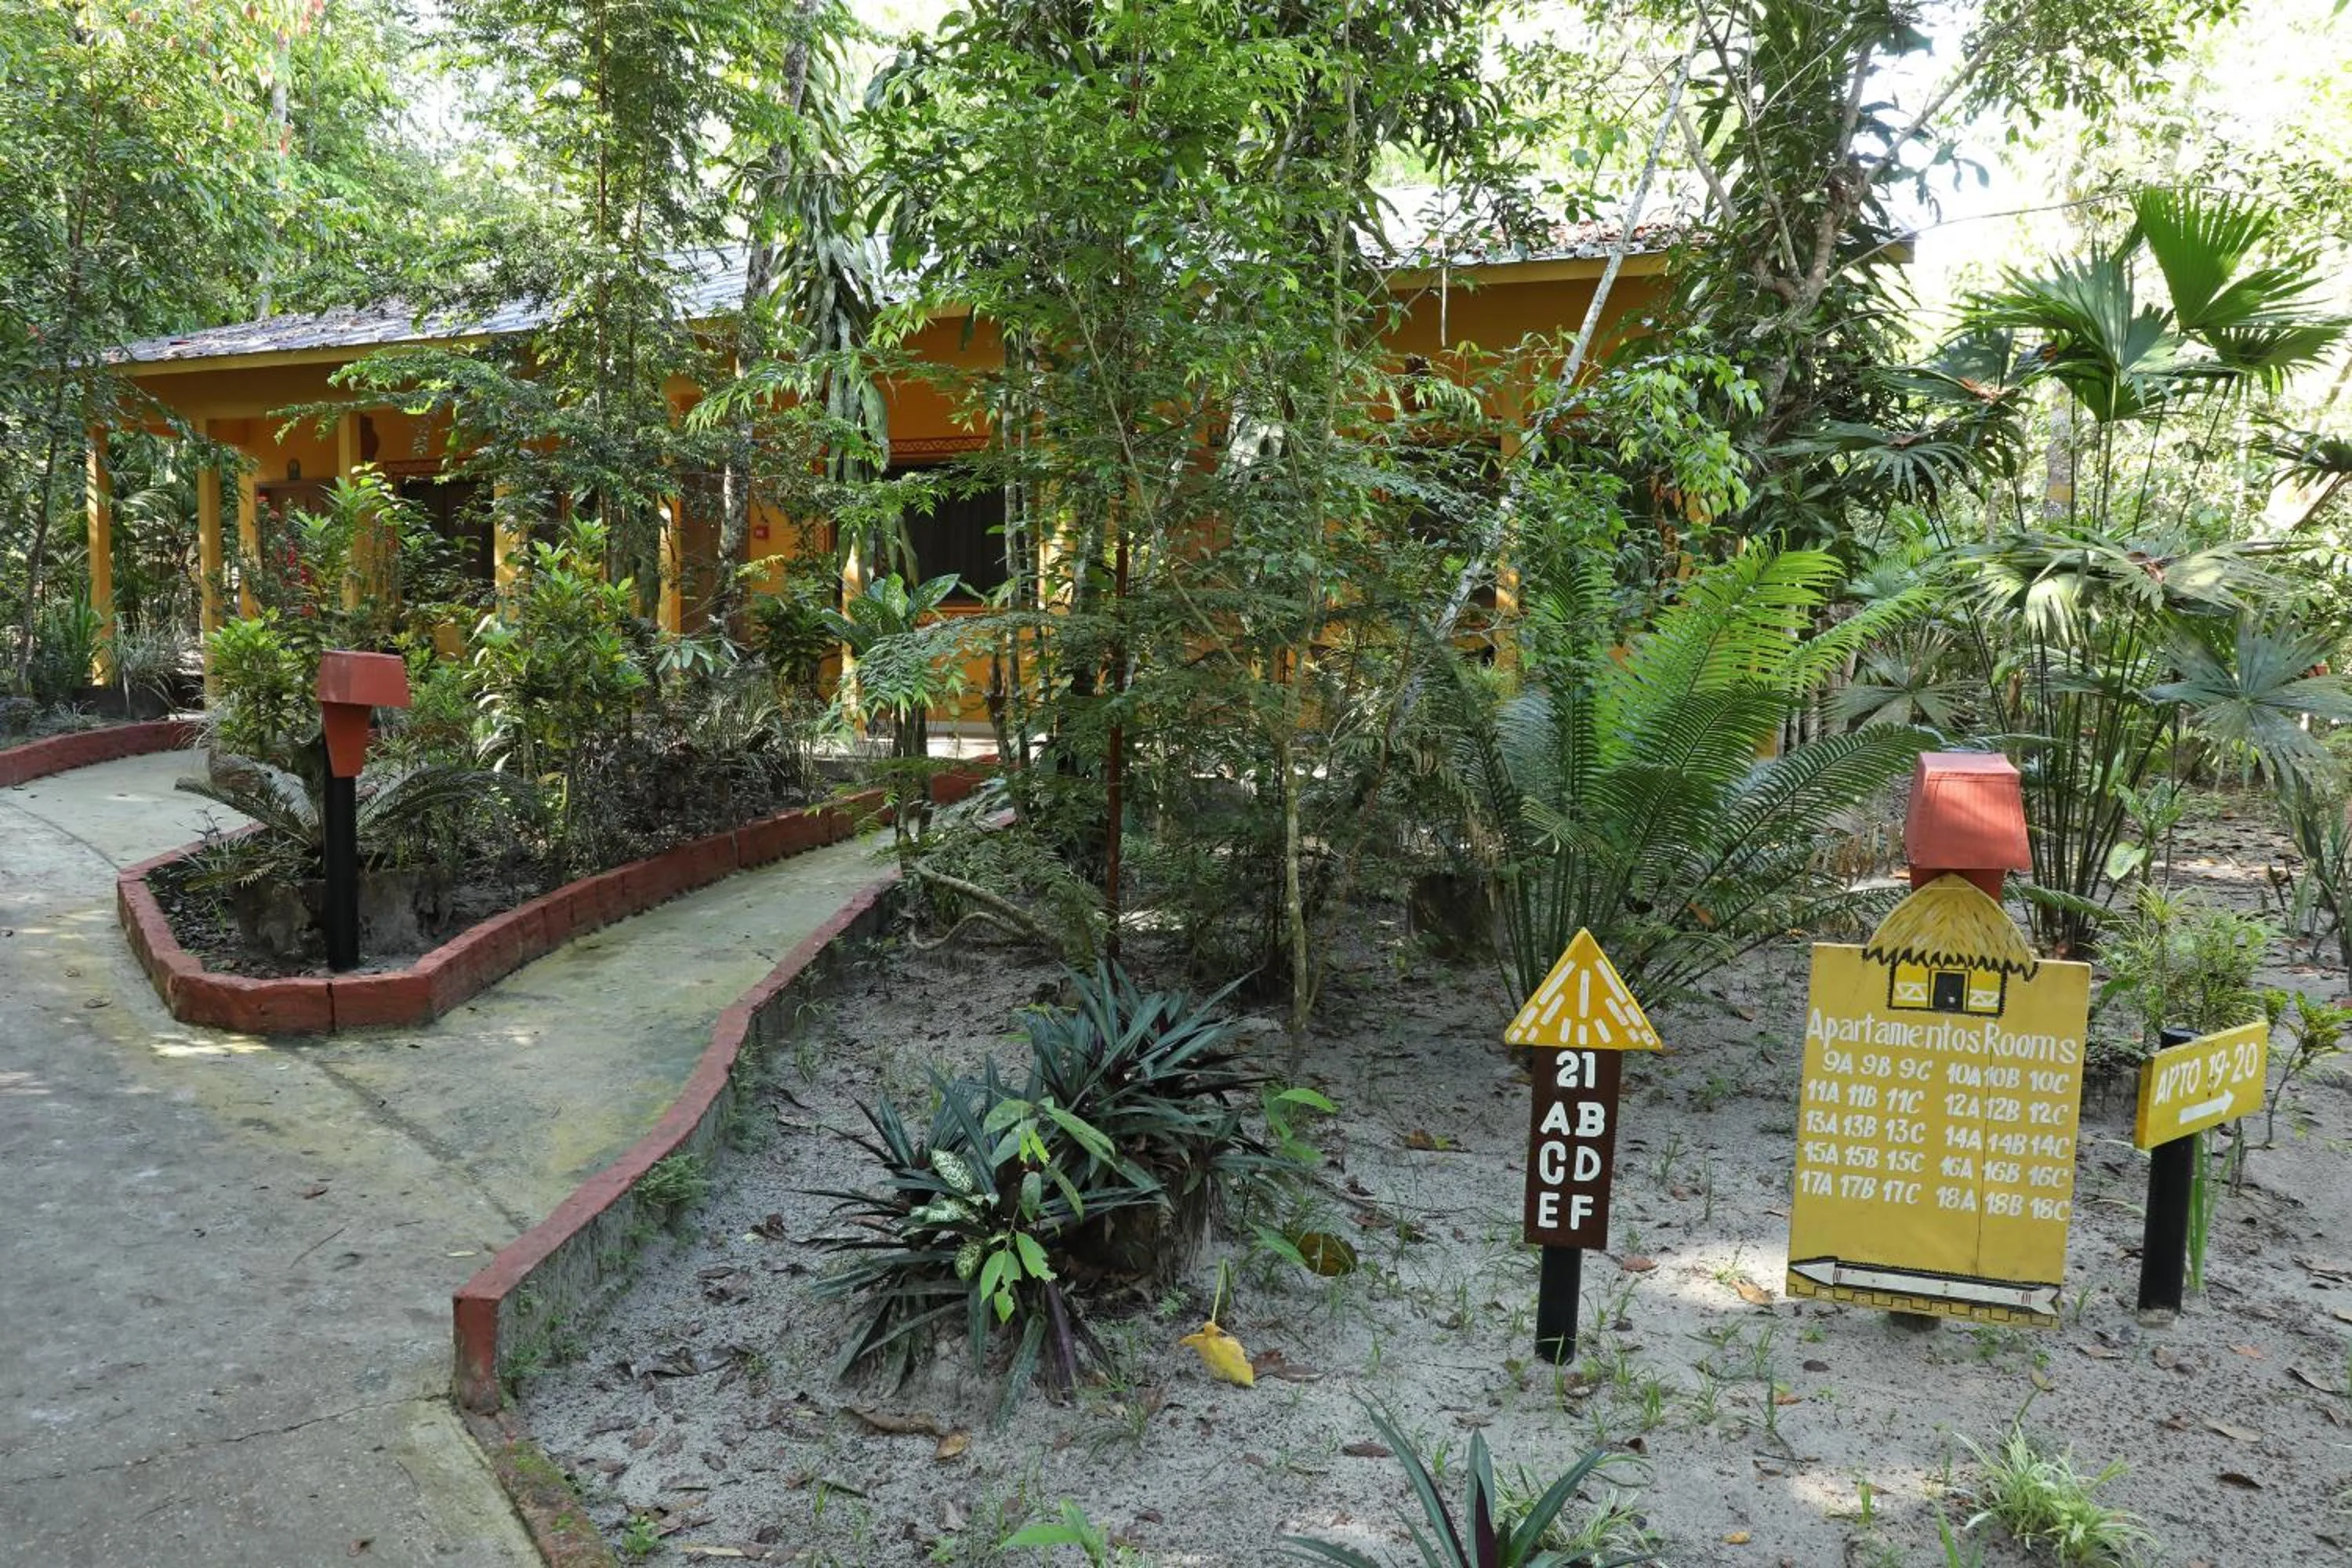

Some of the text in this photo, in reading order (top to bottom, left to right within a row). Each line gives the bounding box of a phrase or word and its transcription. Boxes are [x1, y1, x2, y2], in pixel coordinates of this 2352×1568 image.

[1806, 1007, 2078, 1064] Apartamentos Rooms
[1555, 1051, 1595, 1088] 21
[1822, 1051, 2070, 1094] 9A 9B 9C 10A 10B 10C
[2155, 1058, 2201, 1105] APTO
[1806, 1079, 2069, 1125] 11A 11B 11C 12A 12B 12C
[1806, 1110, 2070, 1159] 13A 13B 13C 14A 14B 14C
[1805, 1142, 2068, 1189] 15A 15B 15C 16A 16B 16C
[1800, 1170, 2071, 1221] 17A 17B 17C 18A 18B 18C
